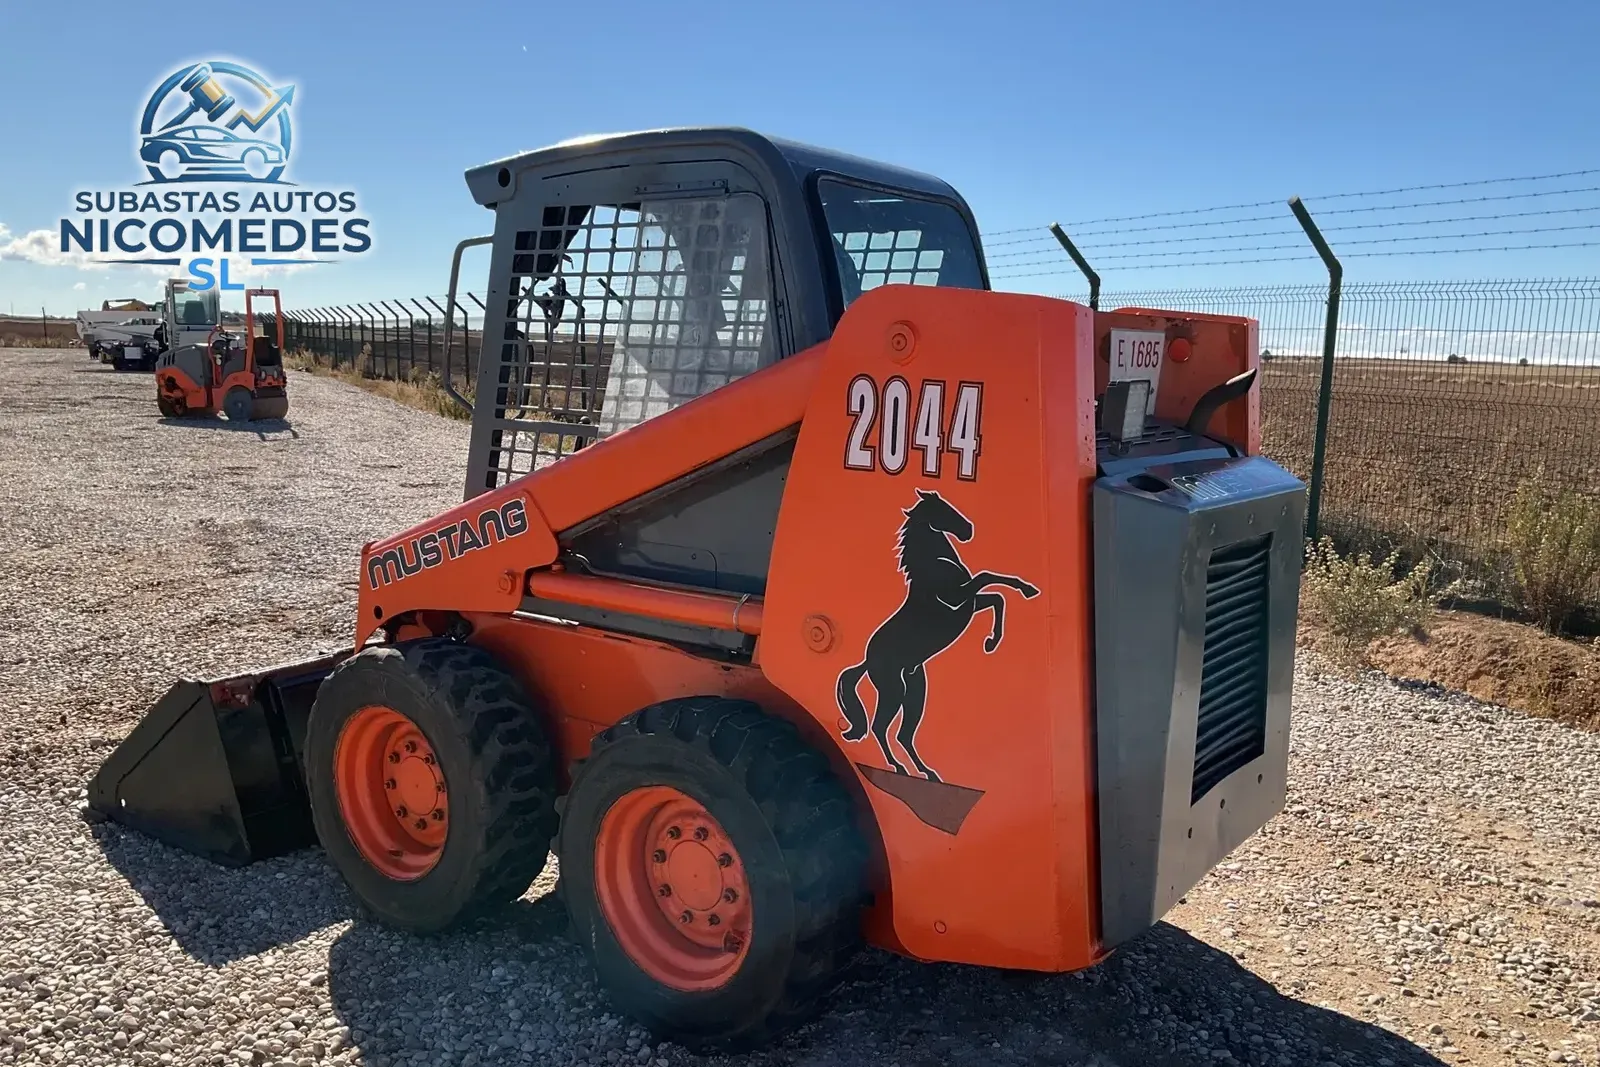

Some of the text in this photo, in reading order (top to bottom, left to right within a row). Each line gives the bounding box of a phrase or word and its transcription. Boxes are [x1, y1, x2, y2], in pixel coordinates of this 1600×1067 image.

[1117, 339, 1161, 369] E 1685
[843, 373, 985, 483] 2044
[367, 498, 529, 590] MUSTANG
